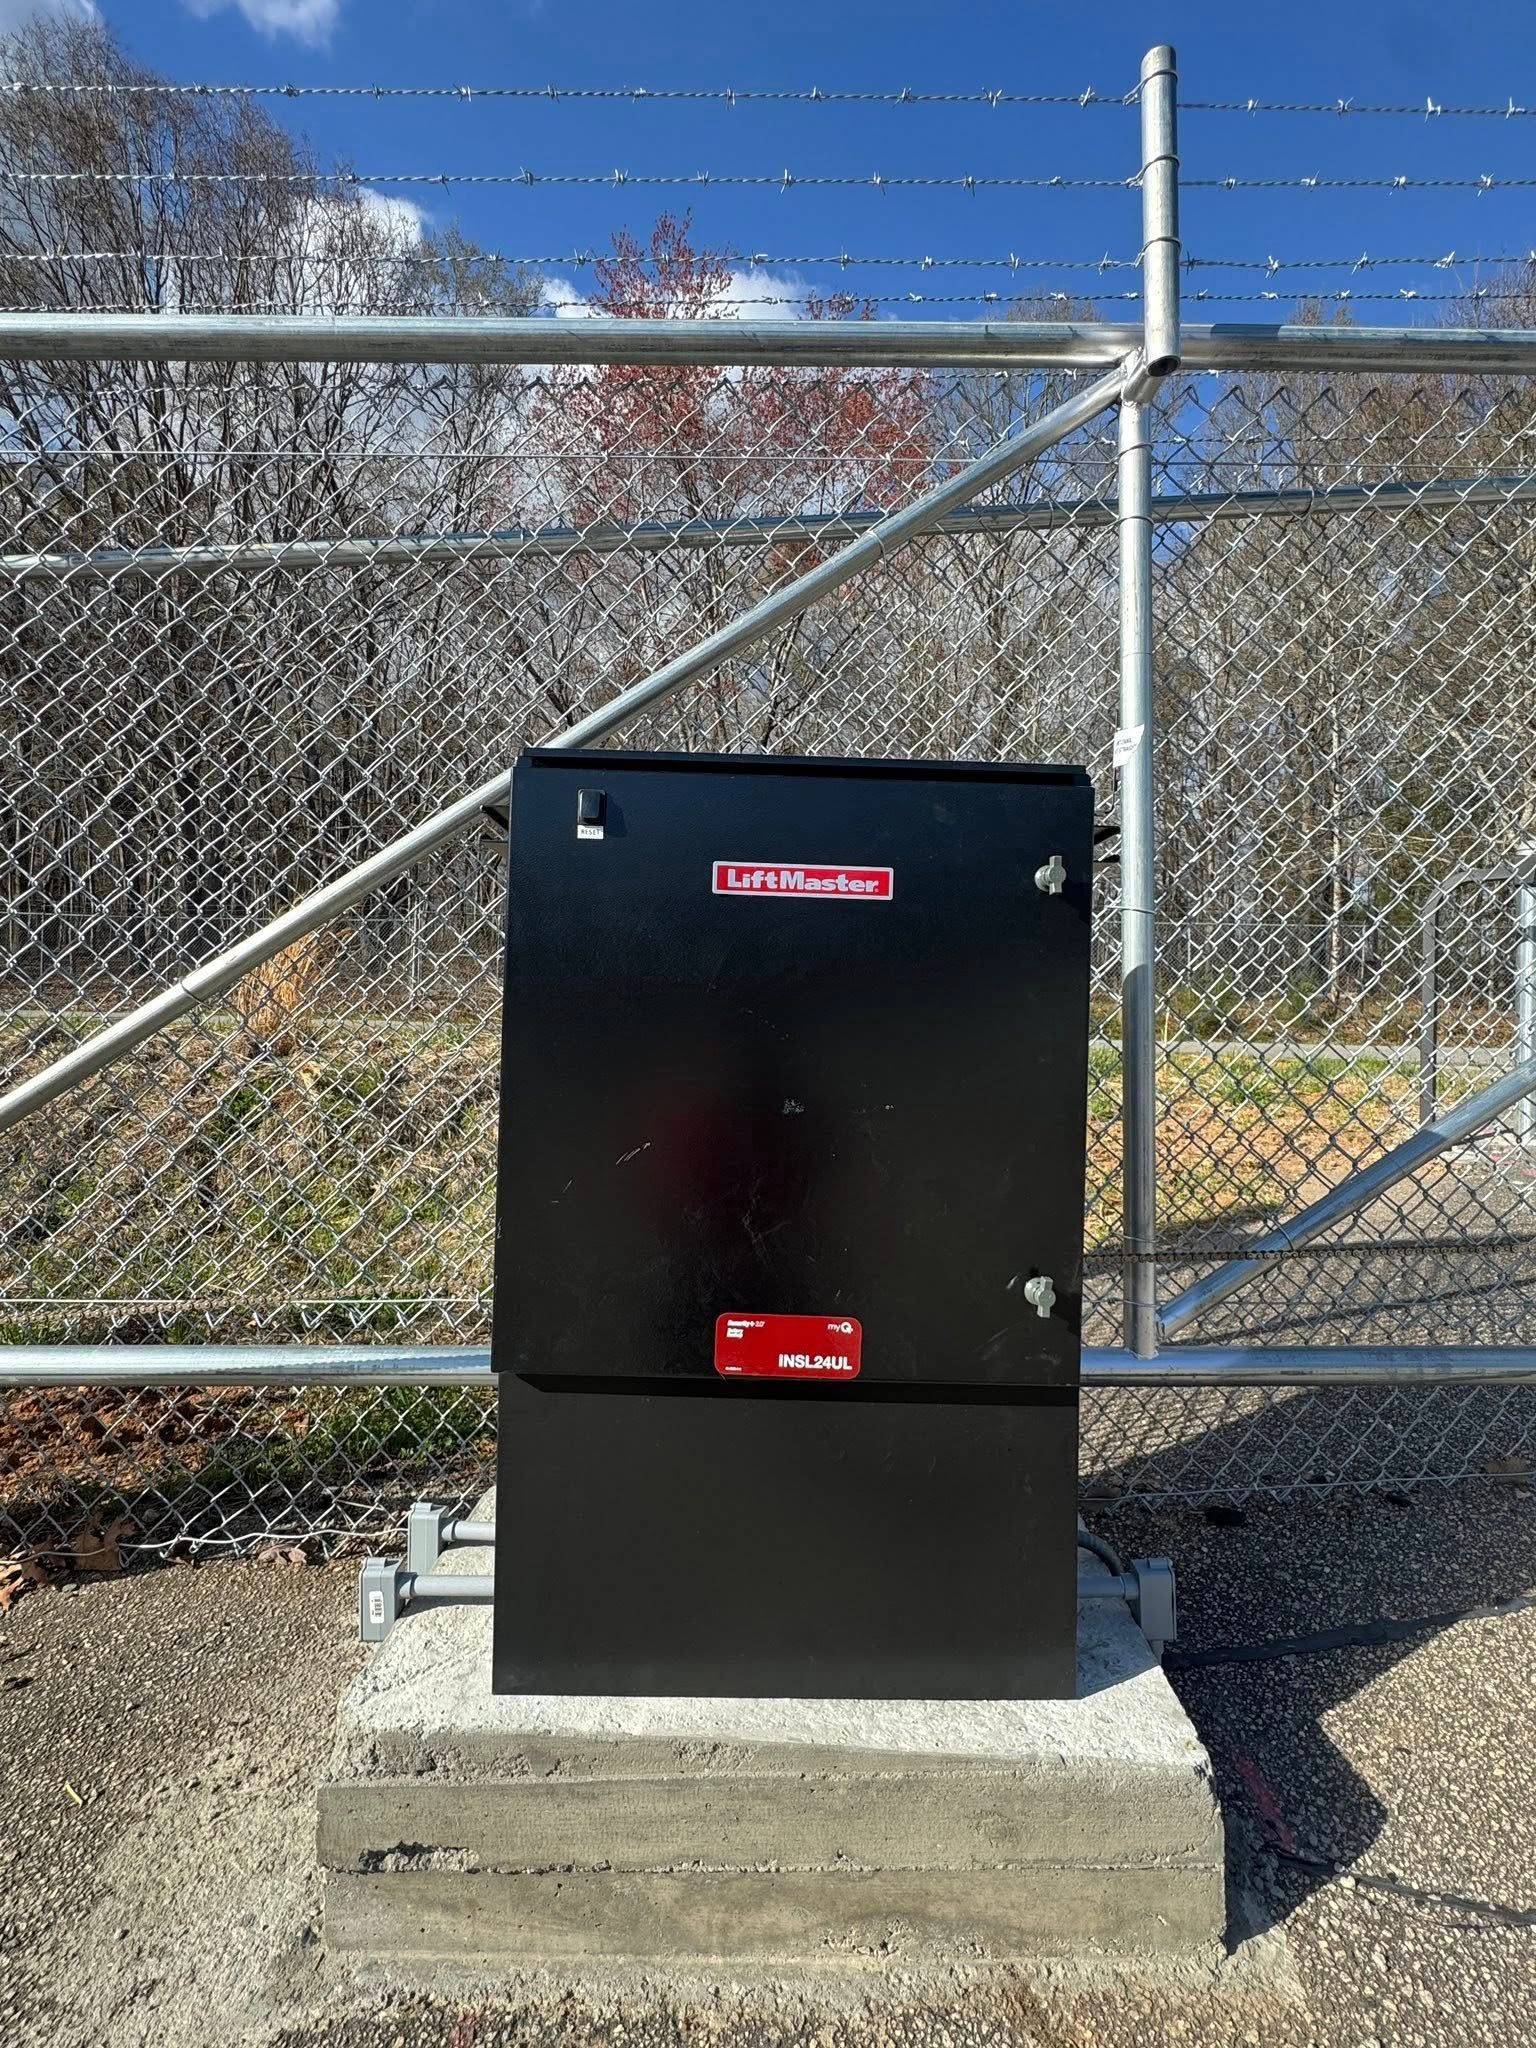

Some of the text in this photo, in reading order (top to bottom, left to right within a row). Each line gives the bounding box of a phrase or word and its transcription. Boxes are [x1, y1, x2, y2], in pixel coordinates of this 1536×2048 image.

[727, 869, 878, 893] LiftMaster
[827, 1321, 853, 1334] myQ
[779, 1353, 853, 1370] INSL24UL
